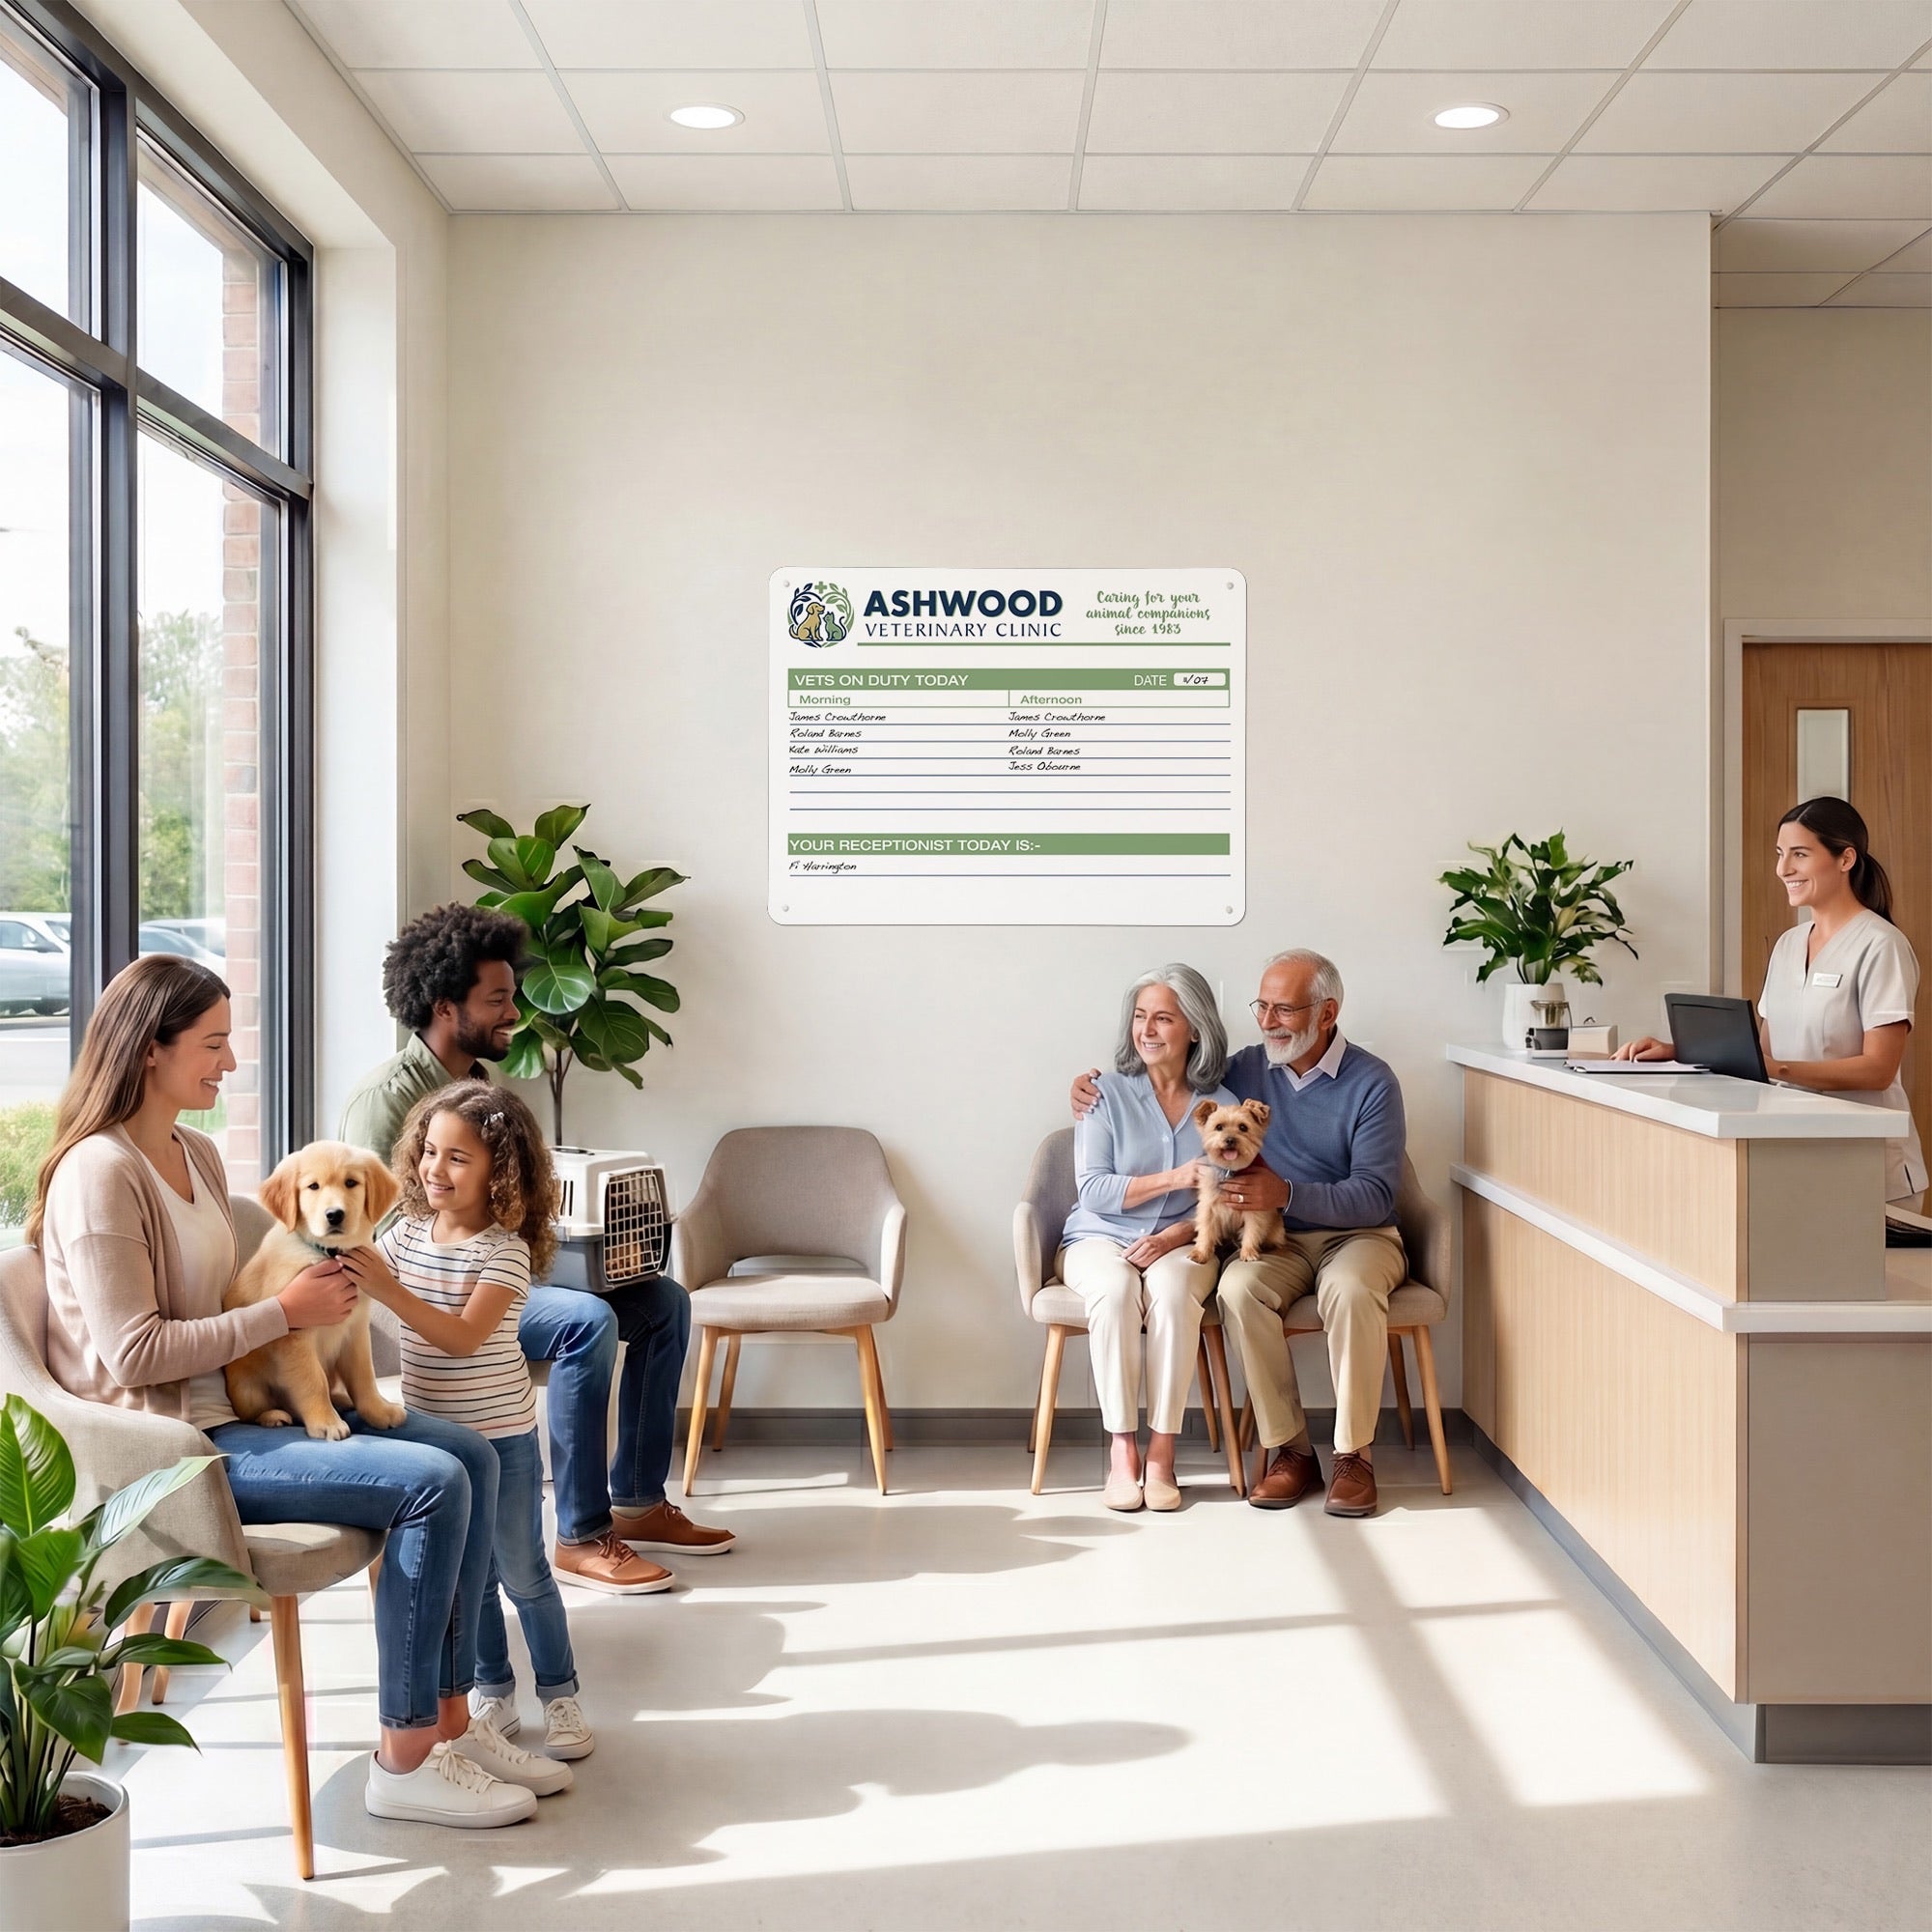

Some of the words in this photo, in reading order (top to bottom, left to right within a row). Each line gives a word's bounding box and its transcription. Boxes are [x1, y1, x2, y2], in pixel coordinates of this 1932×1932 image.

[863, 589, 1064, 617] ASHWOOD
[1097, 590, 1140, 609] Caring
[1146, 591, 1165, 606] for
[1170, 592, 1201, 609] your
[1086, 607, 1132, 619] animal
[1137, 609, 1210, 623] companions
[866, 623, 987, 638] VETERINARY
[996, 623, 1062, 638] CLINIC
[1115, 623, 1146, 636] since
[1151, 623, 1181, 635] 1983
[795, 675, 835, 686] VETS
[839, 675, 863, 686] ON
[868, 675, 910, 686] DUTY
[915, 675, 968, 686] TODAY
[1135, 675, 1166, 686] DATE
[800, 696, 850, 705] Morning
[1021, 696, 1082, 704] Afternoon
[789, 712, 820, 721] James
[1009, 712, 1039, 721] James
[790, 728, 825, 737] Roland
[1009, 729, 1037, 740] Molly
[1041, 728, 1070, 737] Green
[814, 745, 858, 753] Williams
[1009, 746, 1043, 754] Roland
[1009, 761, 1033, 770] Jess
[1037, 761, 1080, 770] Obourne
[789, 765, 817, 778] Molly
[822, 765, 851, 774] Green
[790, 840, 834, 850] YOUR
[839, 840, 952, 850] RECEPTIONIST
[957, 839, 1010, 850] TODAY
[1016, 840, 1040, 850] IS:-
[789, 861, 800, 869] Fi
[804, 862, 856, 873] Harrington
